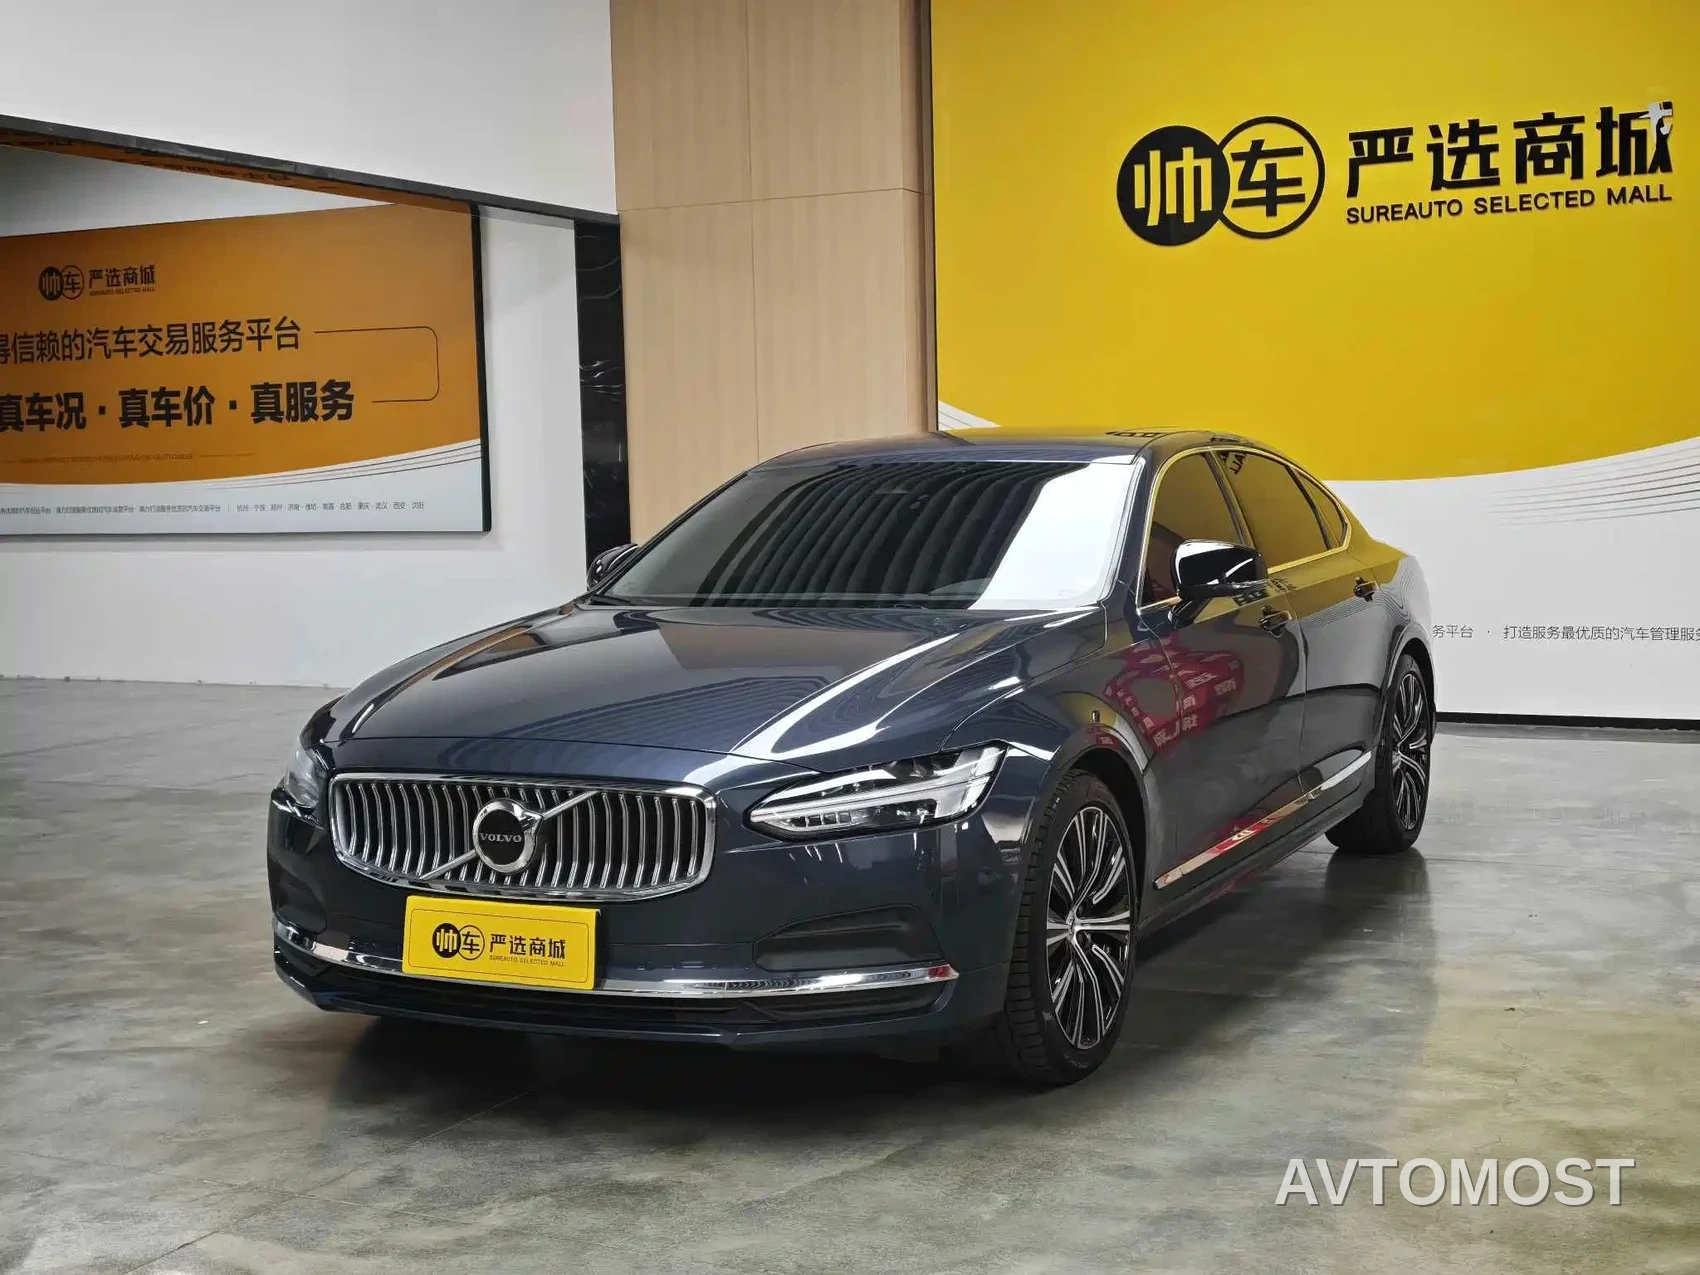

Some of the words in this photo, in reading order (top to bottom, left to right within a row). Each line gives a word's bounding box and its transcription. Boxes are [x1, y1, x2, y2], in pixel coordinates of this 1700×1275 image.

[1346, 101, 1674, 199] 严选商城
[1346, 199, 1464, 225] SUREAUTO
[1473, 189, 1596, 213] SELECTED
[1607, 183, 1674, 205] MALL
[0, 392, 86, 432] 真车况
[118, 386, 216, 429] 真车价
[250, 379, 354, 424] 真服务
[479, 832, 522, 843] VOLVO
[490, 933, 565, 960] 严选商城
